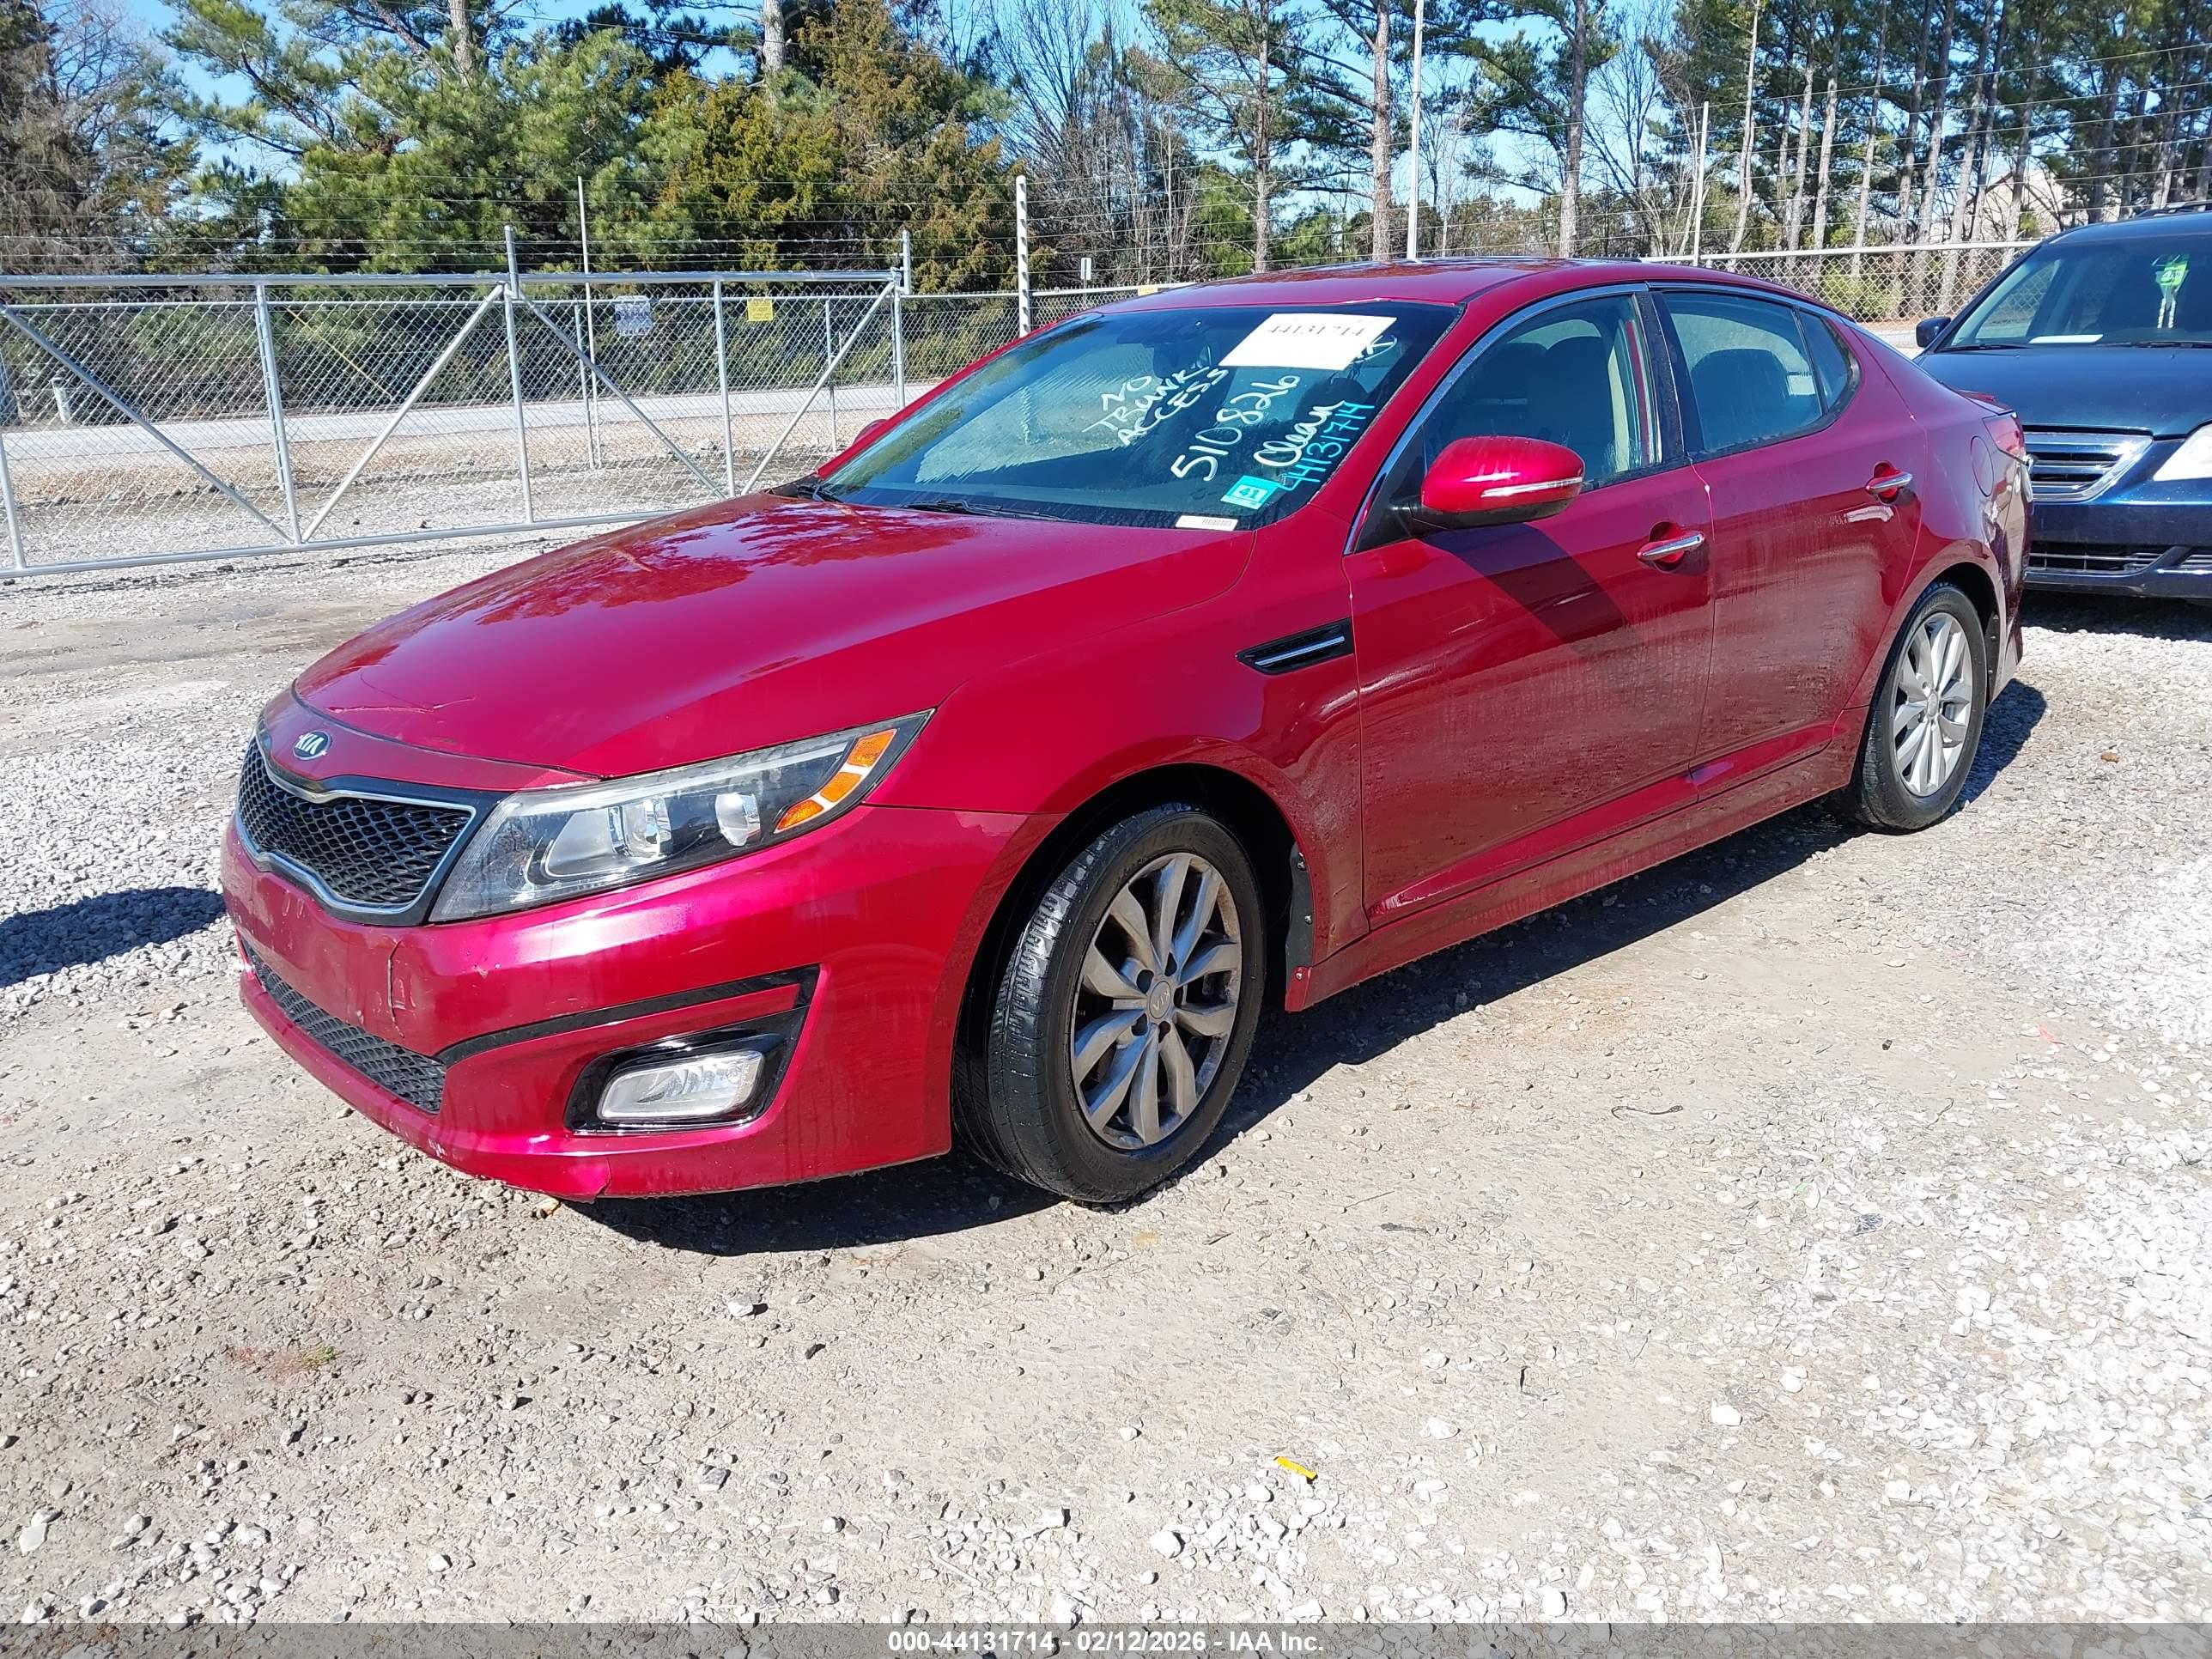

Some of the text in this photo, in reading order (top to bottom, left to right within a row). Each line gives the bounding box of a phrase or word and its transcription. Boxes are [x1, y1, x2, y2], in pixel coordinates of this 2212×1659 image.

[1081, 366, 1210, 433] TRUNK
[1101, 375, 1152, 411] NO
[1117, 368, 1229, 447] ACCESS
[1279, 401, 1376, 491] 44131714
[295, 732, 325, 755] KIA
